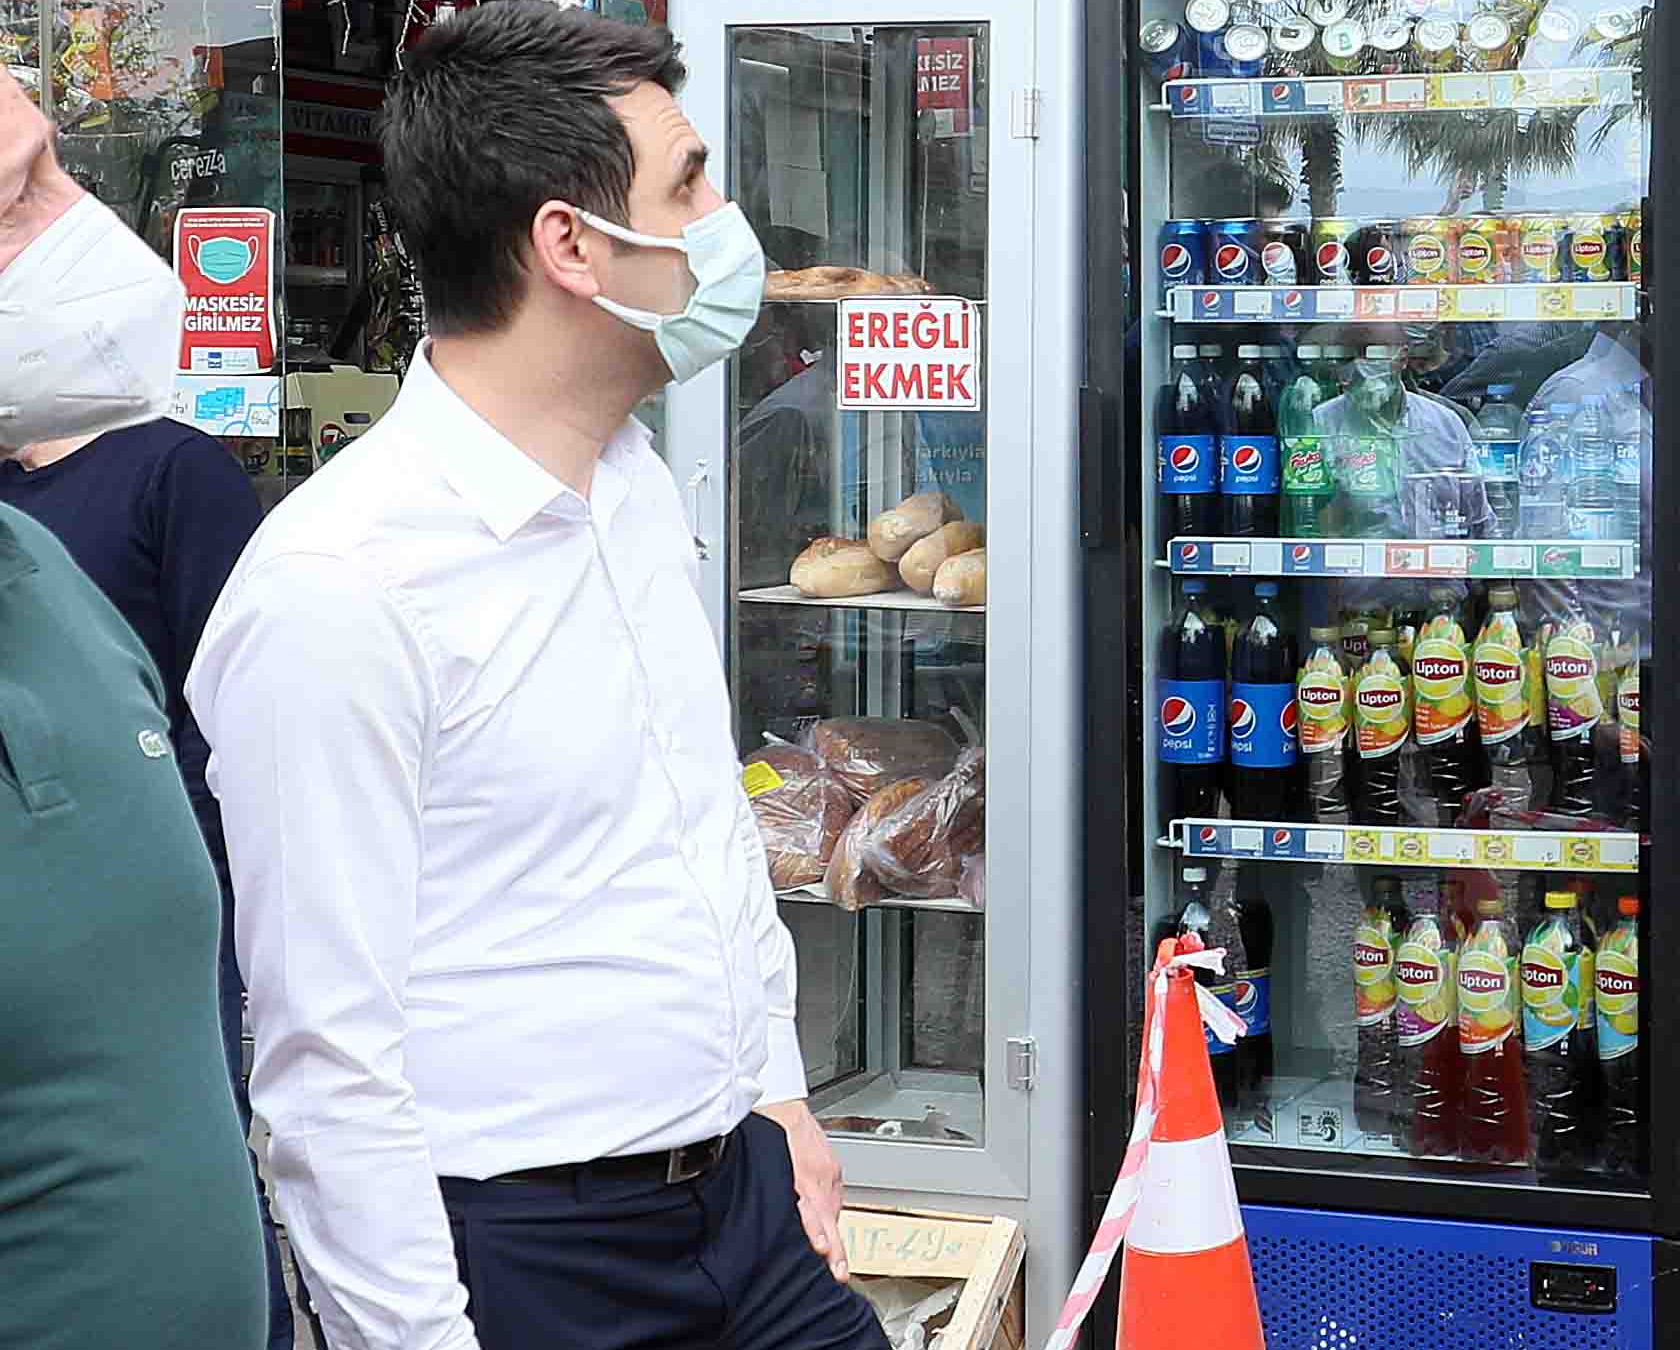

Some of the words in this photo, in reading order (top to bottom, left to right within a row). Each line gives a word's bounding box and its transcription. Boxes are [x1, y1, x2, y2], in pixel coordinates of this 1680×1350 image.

[182, 292, 265, 312] MASKESİZ
[184, 312, 263, 332] GİRİLMEZ
[847, 301, 970, 349] EREĞLİ
[843, 361, 972, 401] EKMEK
[1415, 661, 1460, 676] Lipton
[1546, 658, 1588, 675] Lipton
[1302, 690, 1337, 702] Lipton
[1360, 692, 1399, 704] Lipton
[1459, 971, 1501, 989] Lipton
